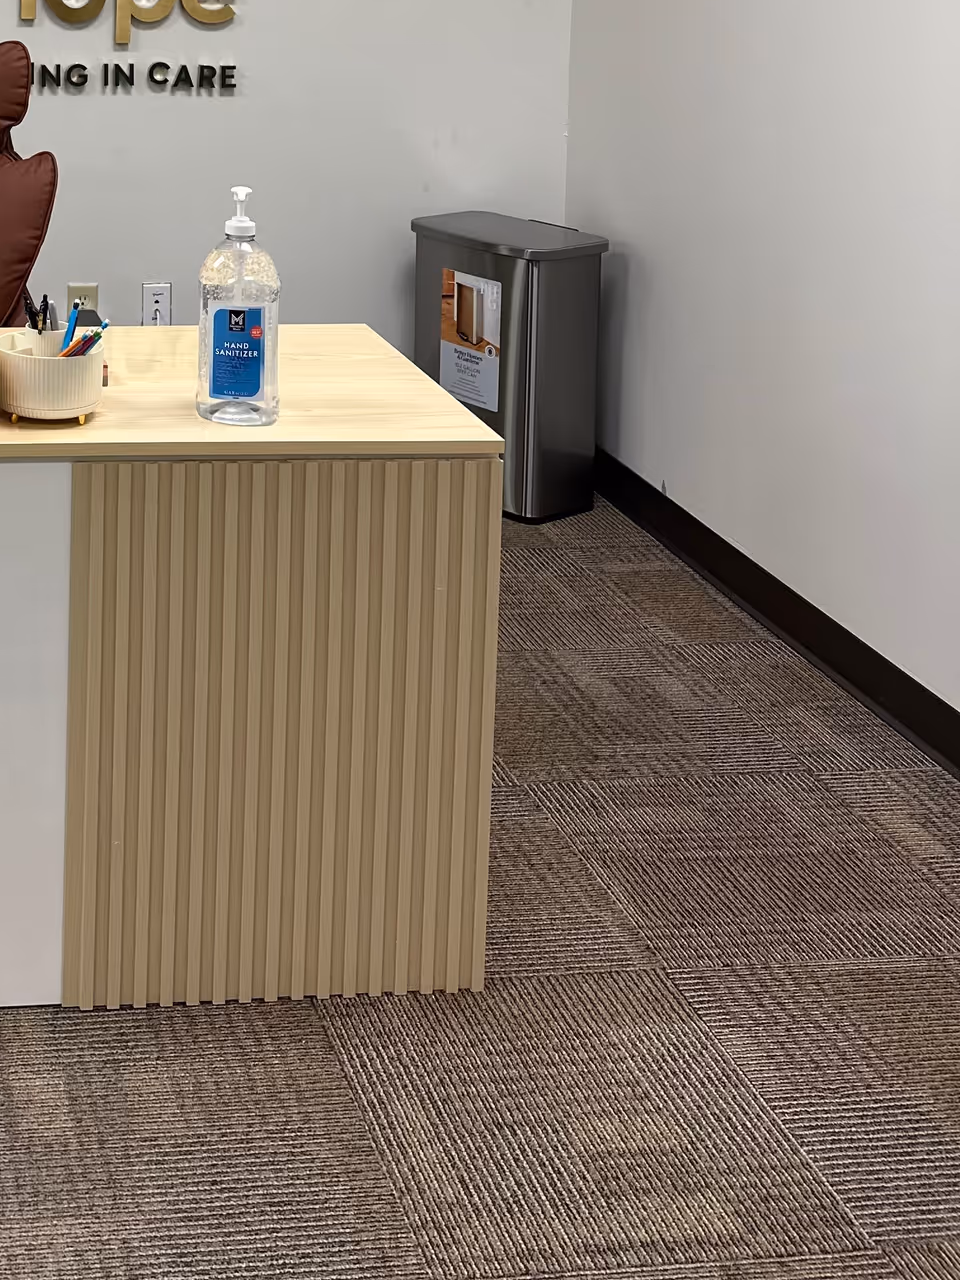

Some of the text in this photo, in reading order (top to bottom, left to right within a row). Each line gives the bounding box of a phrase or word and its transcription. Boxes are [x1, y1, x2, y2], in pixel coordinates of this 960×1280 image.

[30, 62, 88, 88] ING
[102, 63, 135, 87] IN
[148, 61, 237, 89] CARE
[224, 341, 249, 349] HAND
[215, 348, 258, 357] SANITIZER
